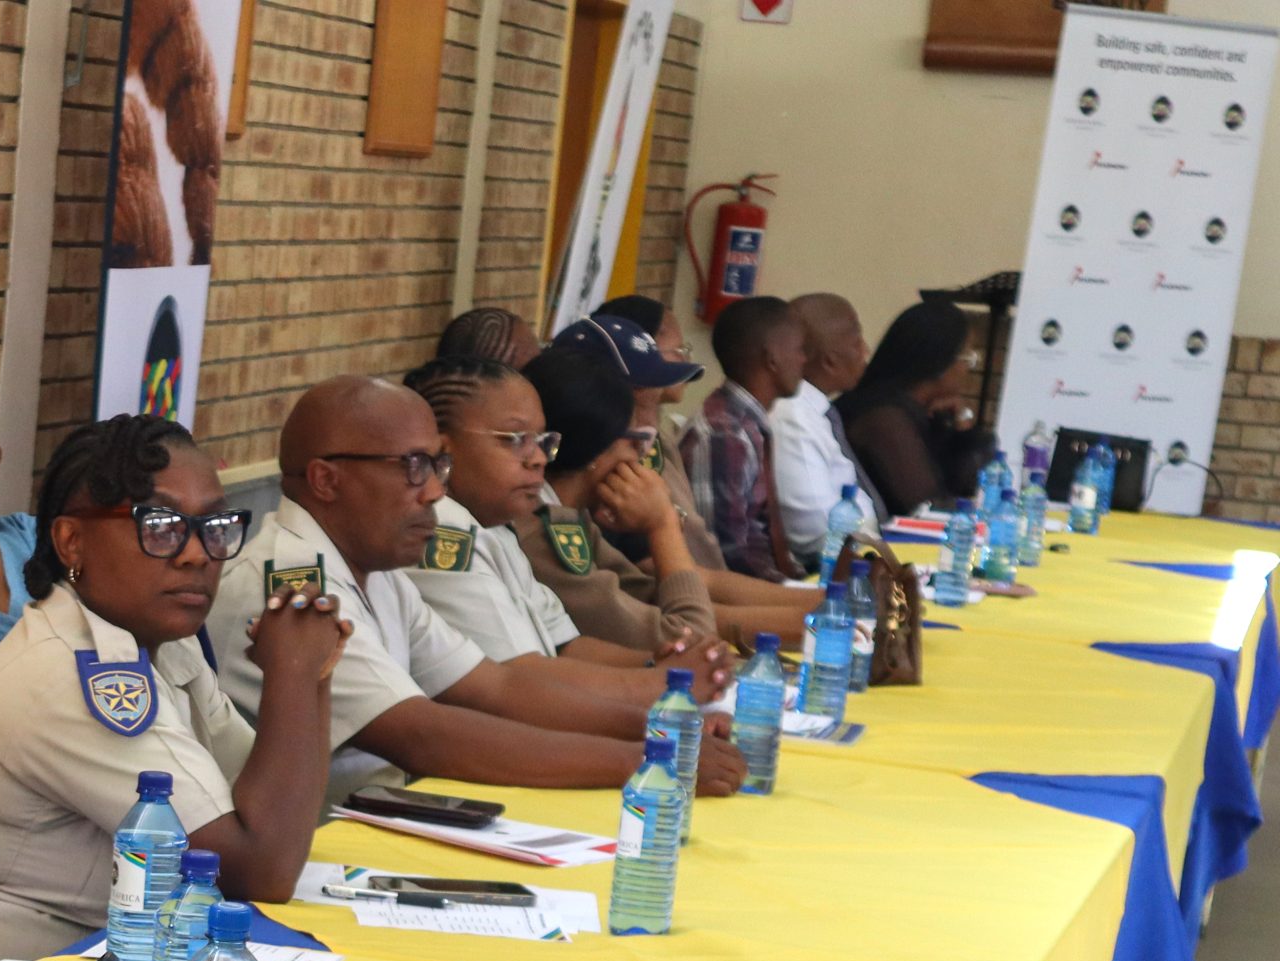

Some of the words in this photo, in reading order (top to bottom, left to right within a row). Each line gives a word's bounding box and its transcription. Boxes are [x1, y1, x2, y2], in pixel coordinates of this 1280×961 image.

[1096, 33, 1141, 53] Building
[1173, 44, 1224, 61] confident
[1226, 50, 1247, 63] and
[1098, 58, 1162, 74] empowered
